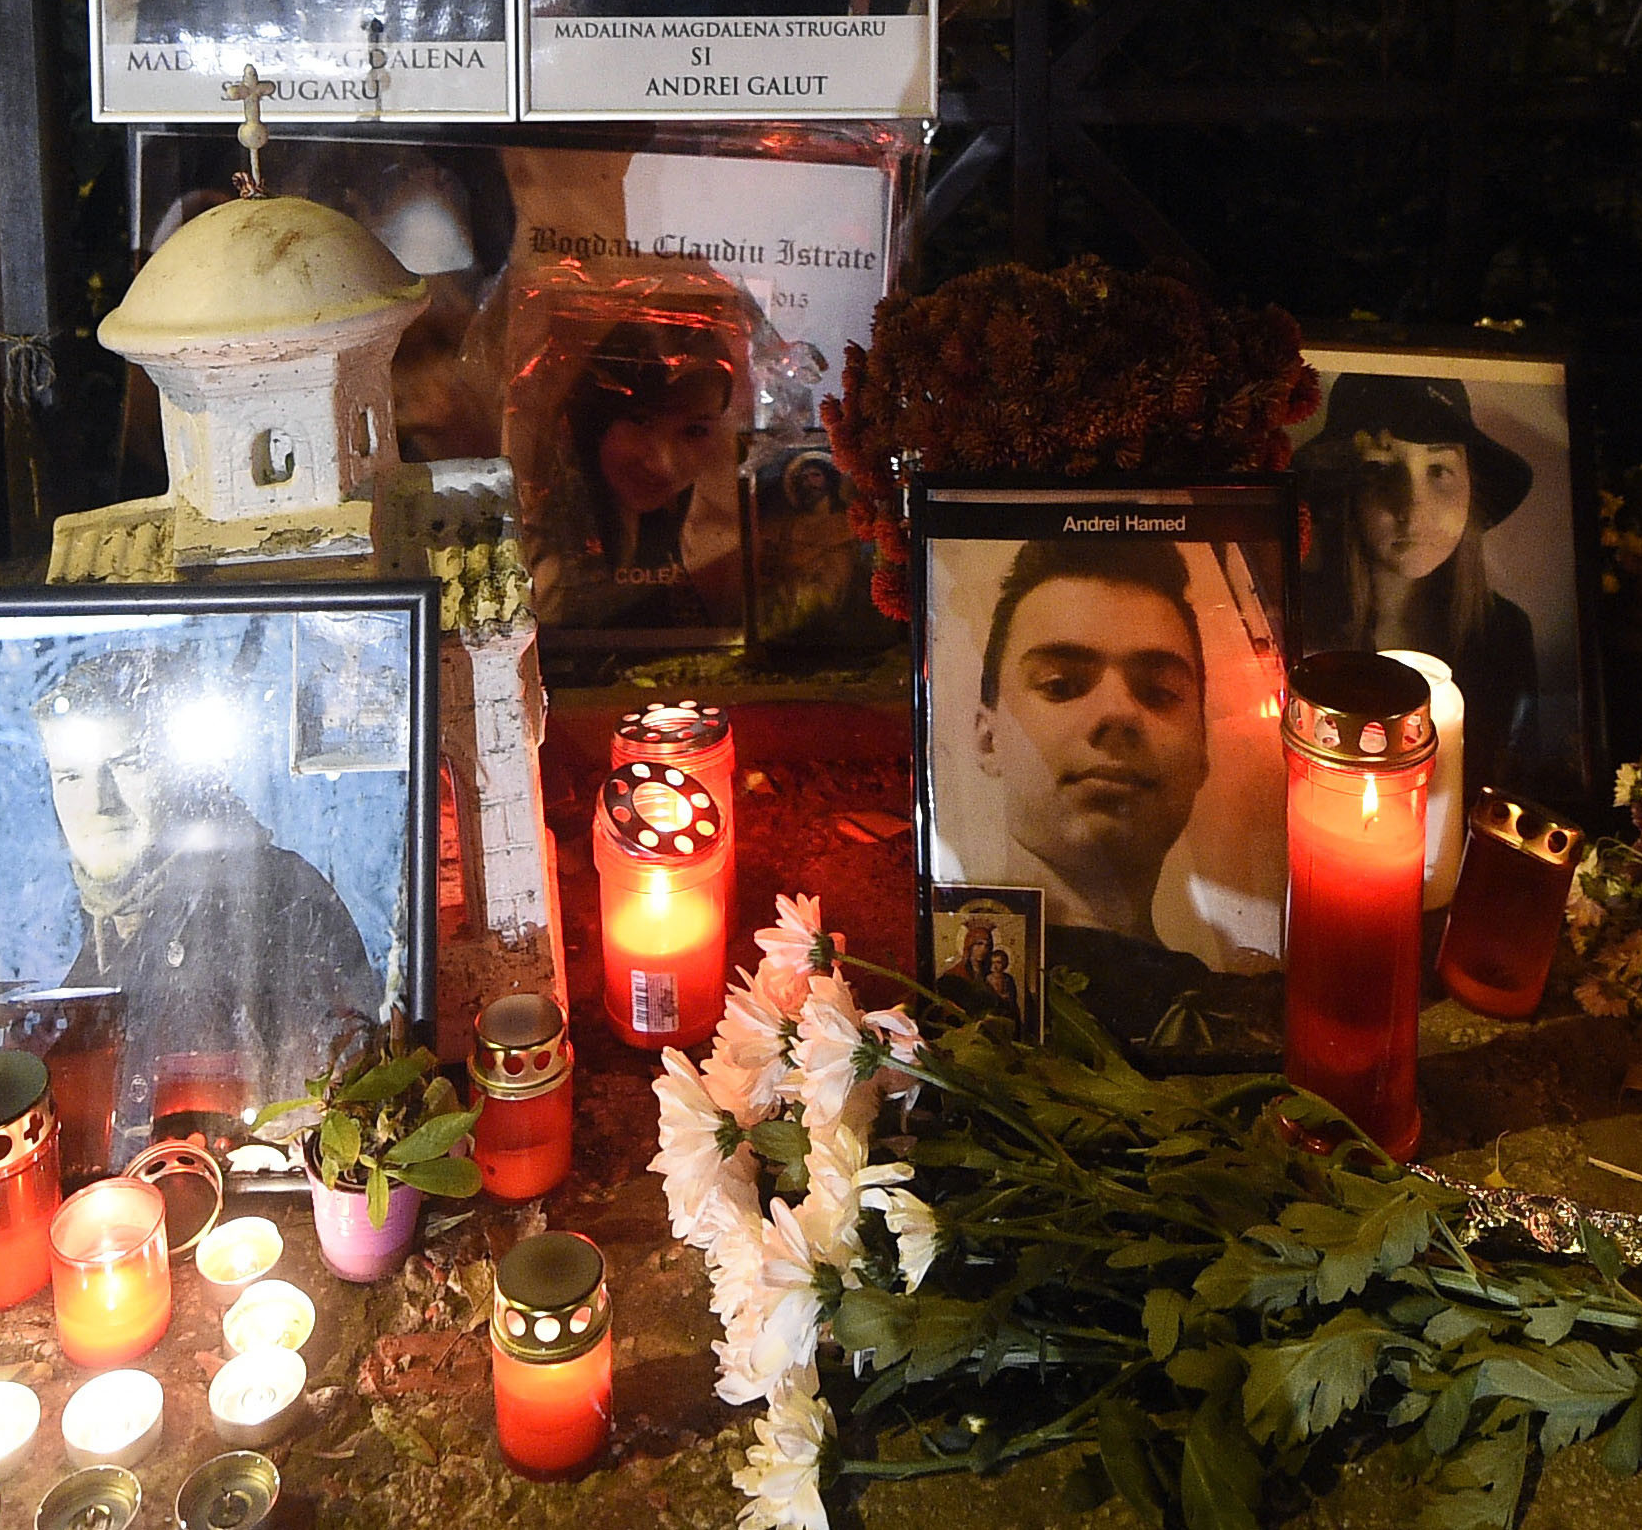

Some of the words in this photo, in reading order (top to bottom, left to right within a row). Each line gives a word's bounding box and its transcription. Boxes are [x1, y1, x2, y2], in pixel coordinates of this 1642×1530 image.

[554, 21, 655, 40] MADALINA
[661, 21, 781, 39] MAGDALENA
[785, 20, 886, 38] STRUGARU
[691, 47, 711, 67] SI
[645, 75, 739, 97] ANDREI
[747, 75, 829, 96] GALUT
[530, 226, 640, 260] Bogdan
[653, 234, 765, 264] Claudiu
[776, 238, 877, 270] Istrate
[1063, 515, 1120, 532] Andrei
[1125, 515, 1186, 532] Hamed
